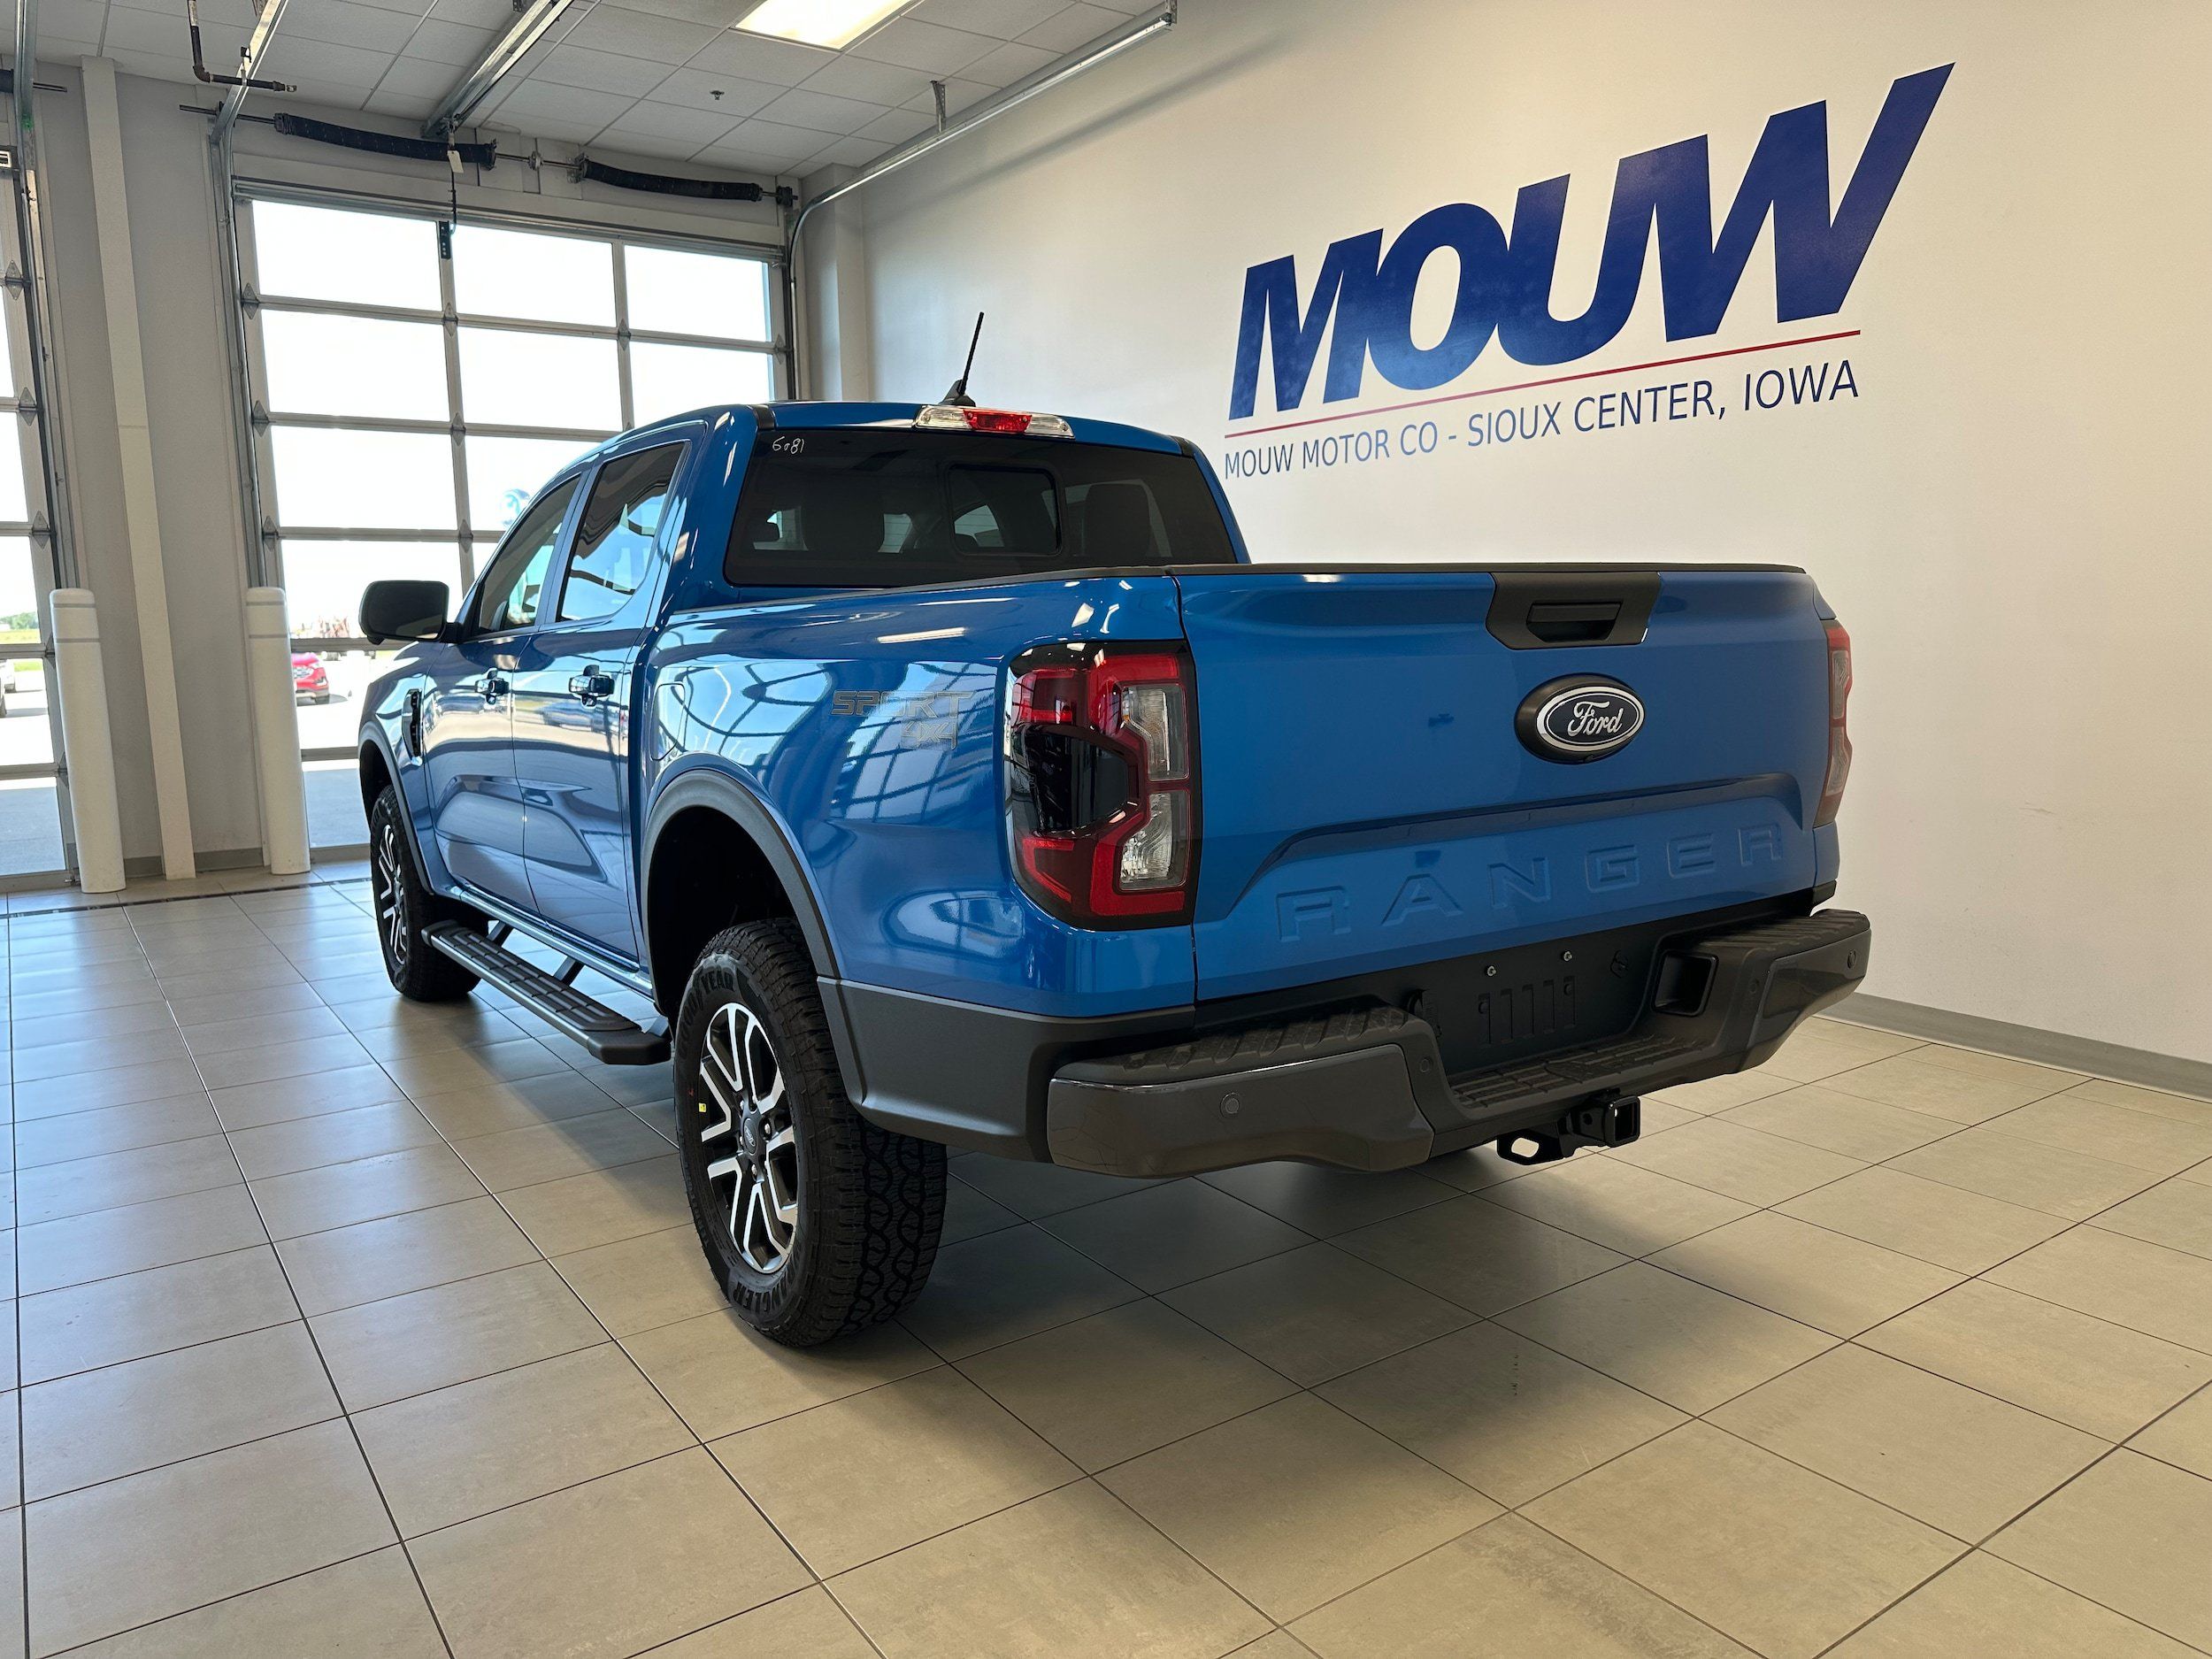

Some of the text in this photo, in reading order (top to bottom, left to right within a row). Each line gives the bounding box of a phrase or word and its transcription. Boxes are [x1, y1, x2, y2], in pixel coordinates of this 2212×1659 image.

[1227, 62, 1955, 421] MOUW
[1225, 442, 1294, 480] MOUW
[1302, 428, 1390, 469] MOTOR
[1400, 420, 1439, 457] CO
[1467, 401, 1562, 447] SIOUX
[1574, 379, 1725, 432] CENTER,
[1744, 359, 1859, 411] IOWA
[830, 690, 974, 719] SPORT
[1567, 701, 1624, 737] Ford
[1275, 822, 1785, 944] RANGER
